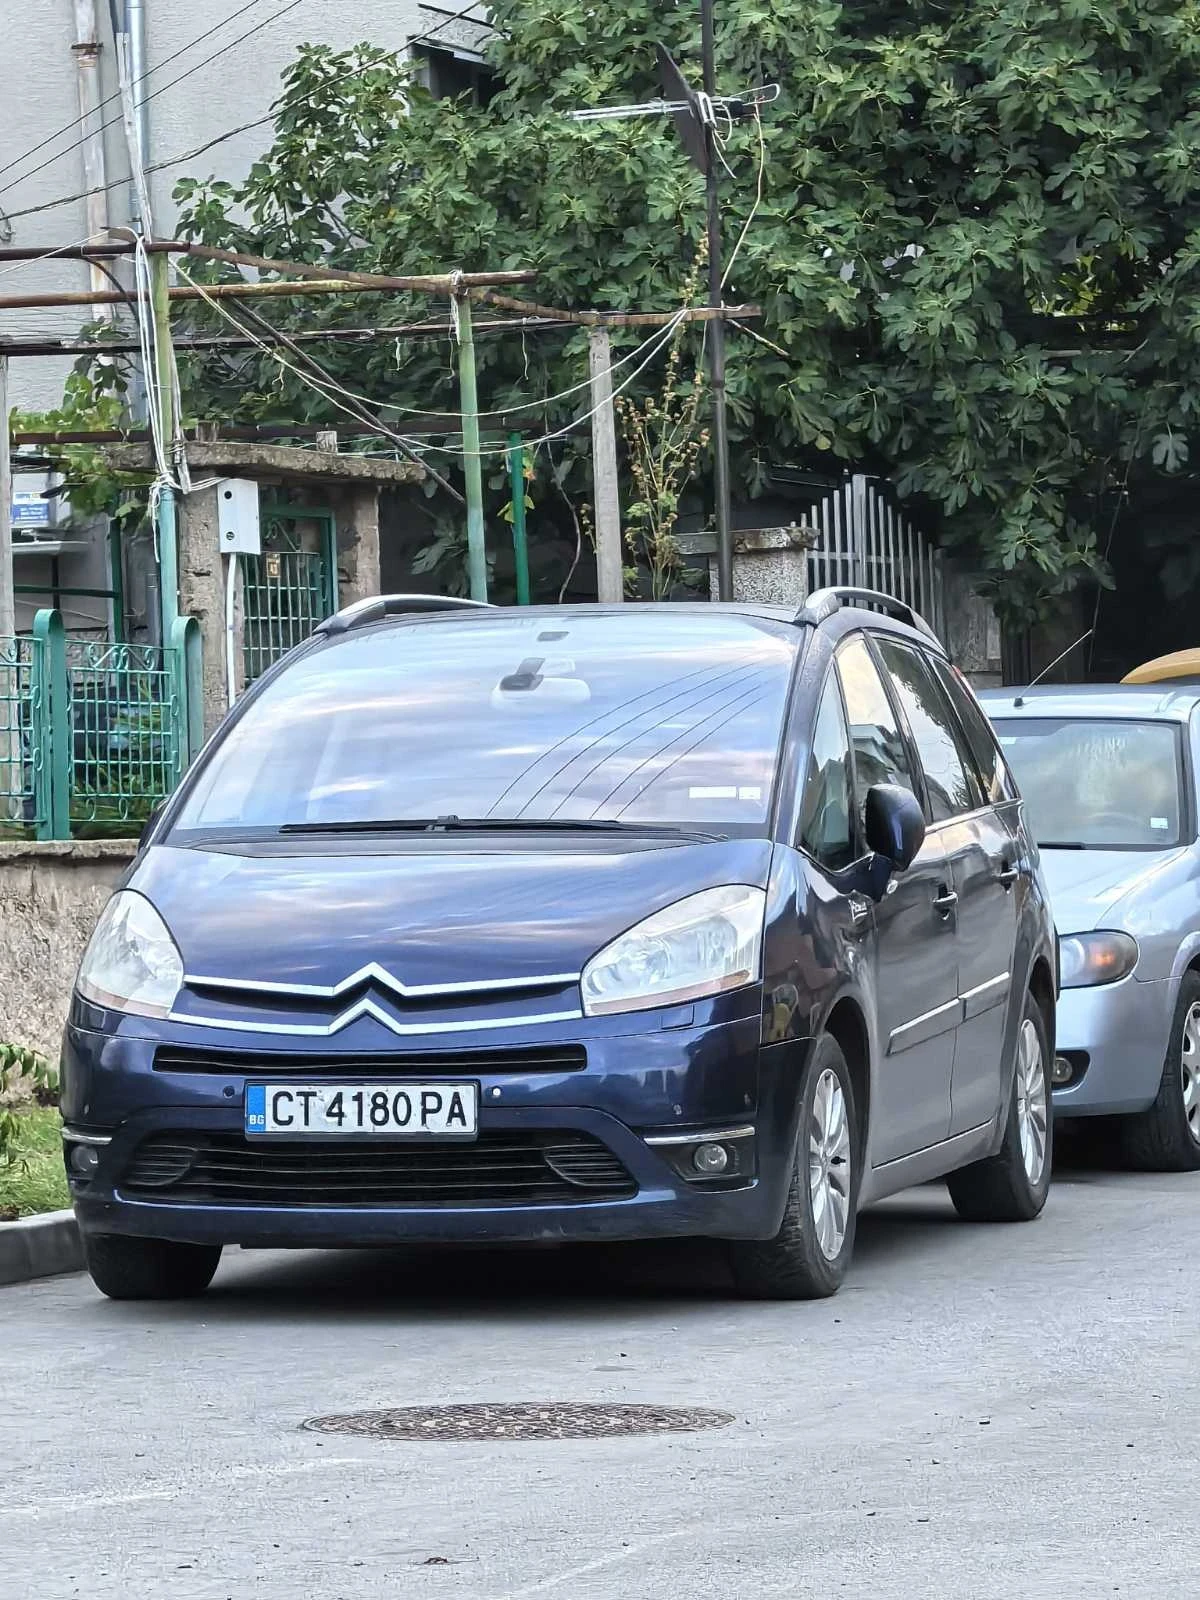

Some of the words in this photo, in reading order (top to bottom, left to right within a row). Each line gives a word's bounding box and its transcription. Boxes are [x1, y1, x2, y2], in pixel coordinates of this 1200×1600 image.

[272, 1091, 317, 1126] CT
[326, 1091, 412, 1126] 4180
[421, 1091, 467, 1126] PA
[249, 1115, 265, 1125] BG
